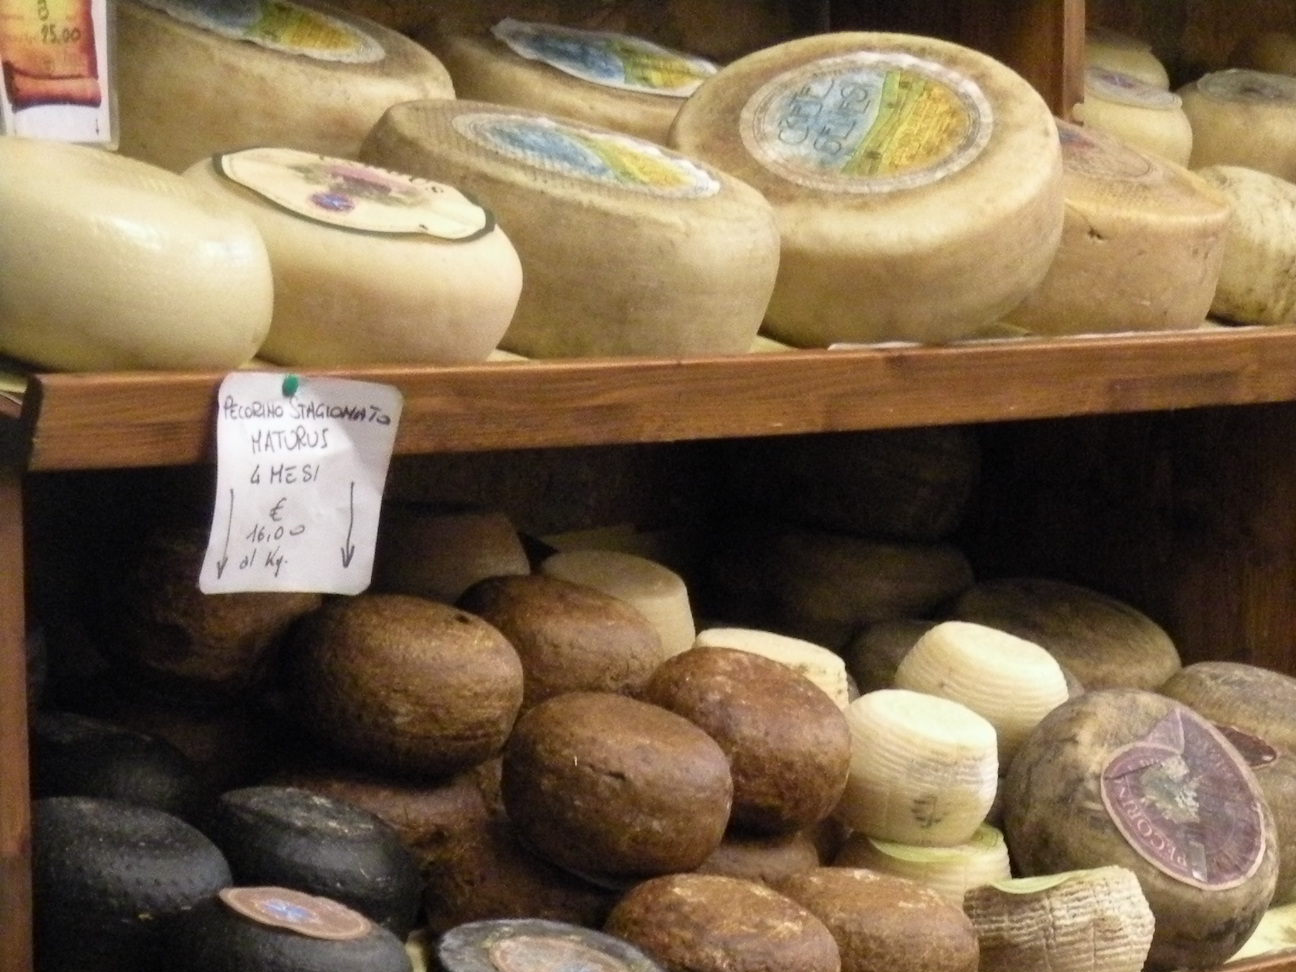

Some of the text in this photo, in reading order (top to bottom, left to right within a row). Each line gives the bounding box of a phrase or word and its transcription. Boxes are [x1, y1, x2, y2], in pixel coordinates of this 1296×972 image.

[223, 395, 392, 425] PECORINO STAGIONATO
[251, 425, 329, 454] MATURUS
[269, 464, 320, 485] MESI
